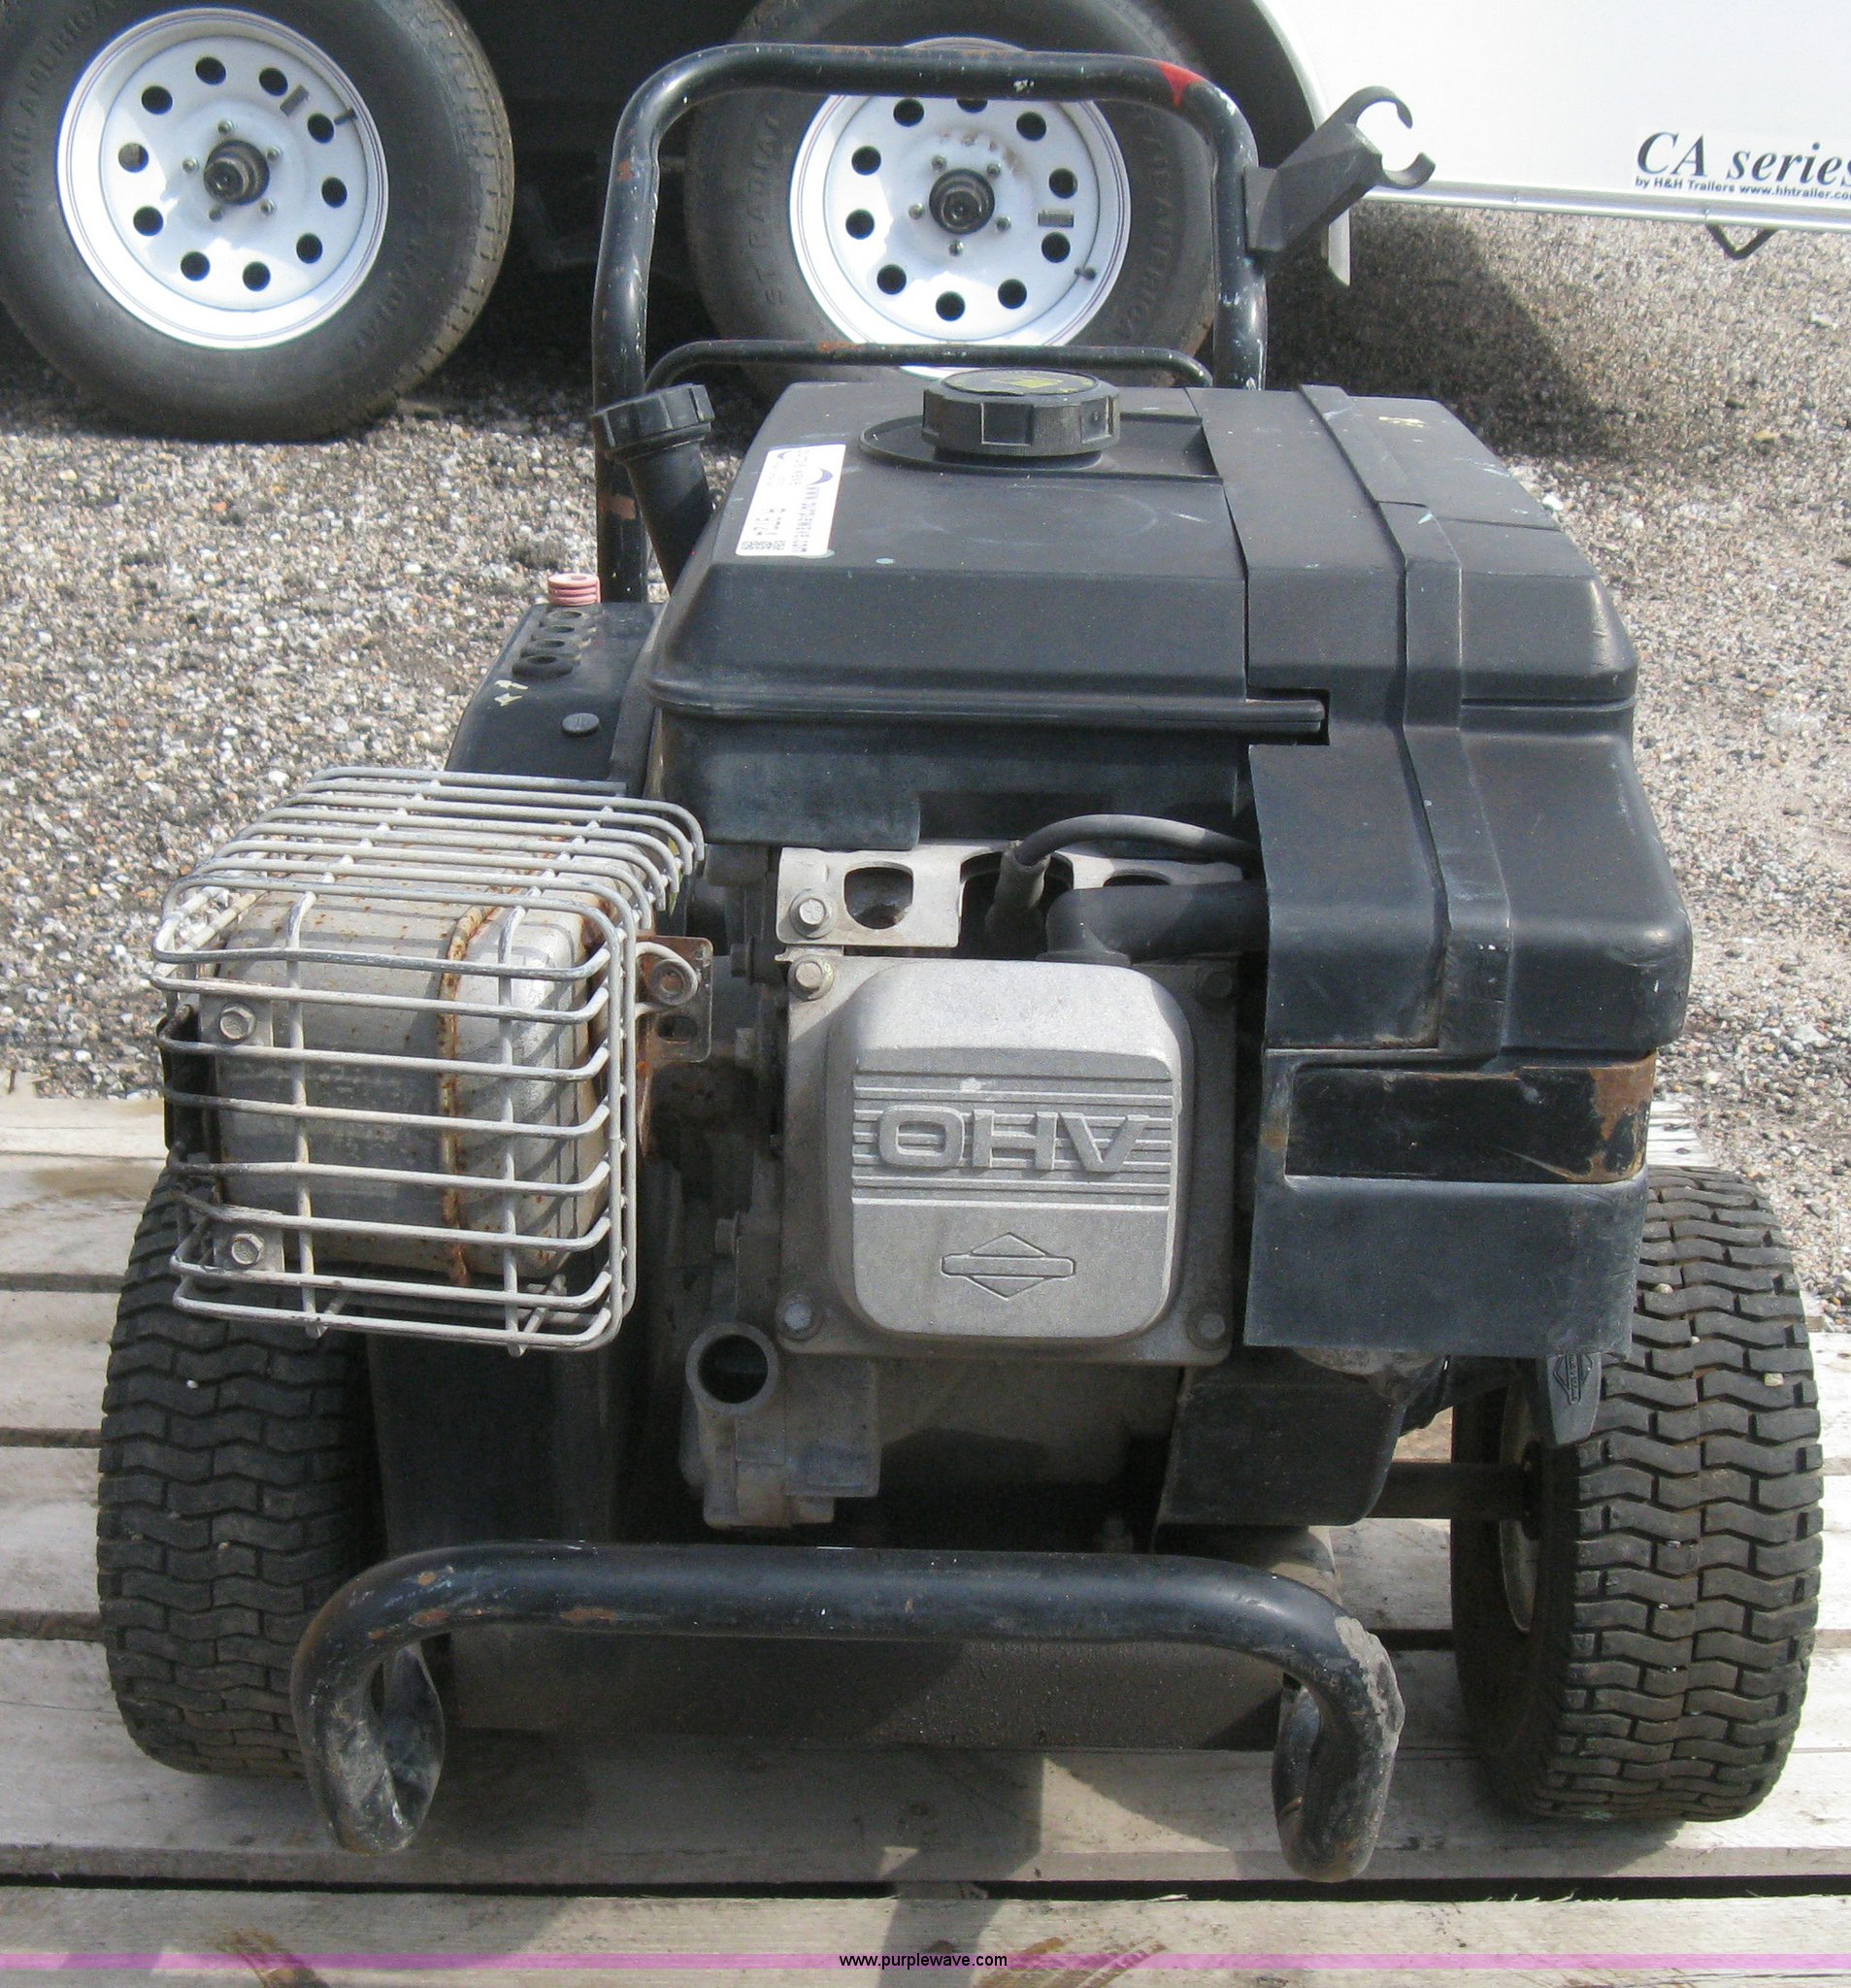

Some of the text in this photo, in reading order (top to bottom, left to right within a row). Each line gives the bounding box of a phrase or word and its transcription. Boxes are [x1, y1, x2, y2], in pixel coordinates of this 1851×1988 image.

[1636, 131, 1707, 178] CA
[1636, 175, 1851, 201] by H&H Trailers www.hhtrailer.co
[878, 1105, 1150, 1173] OHV
